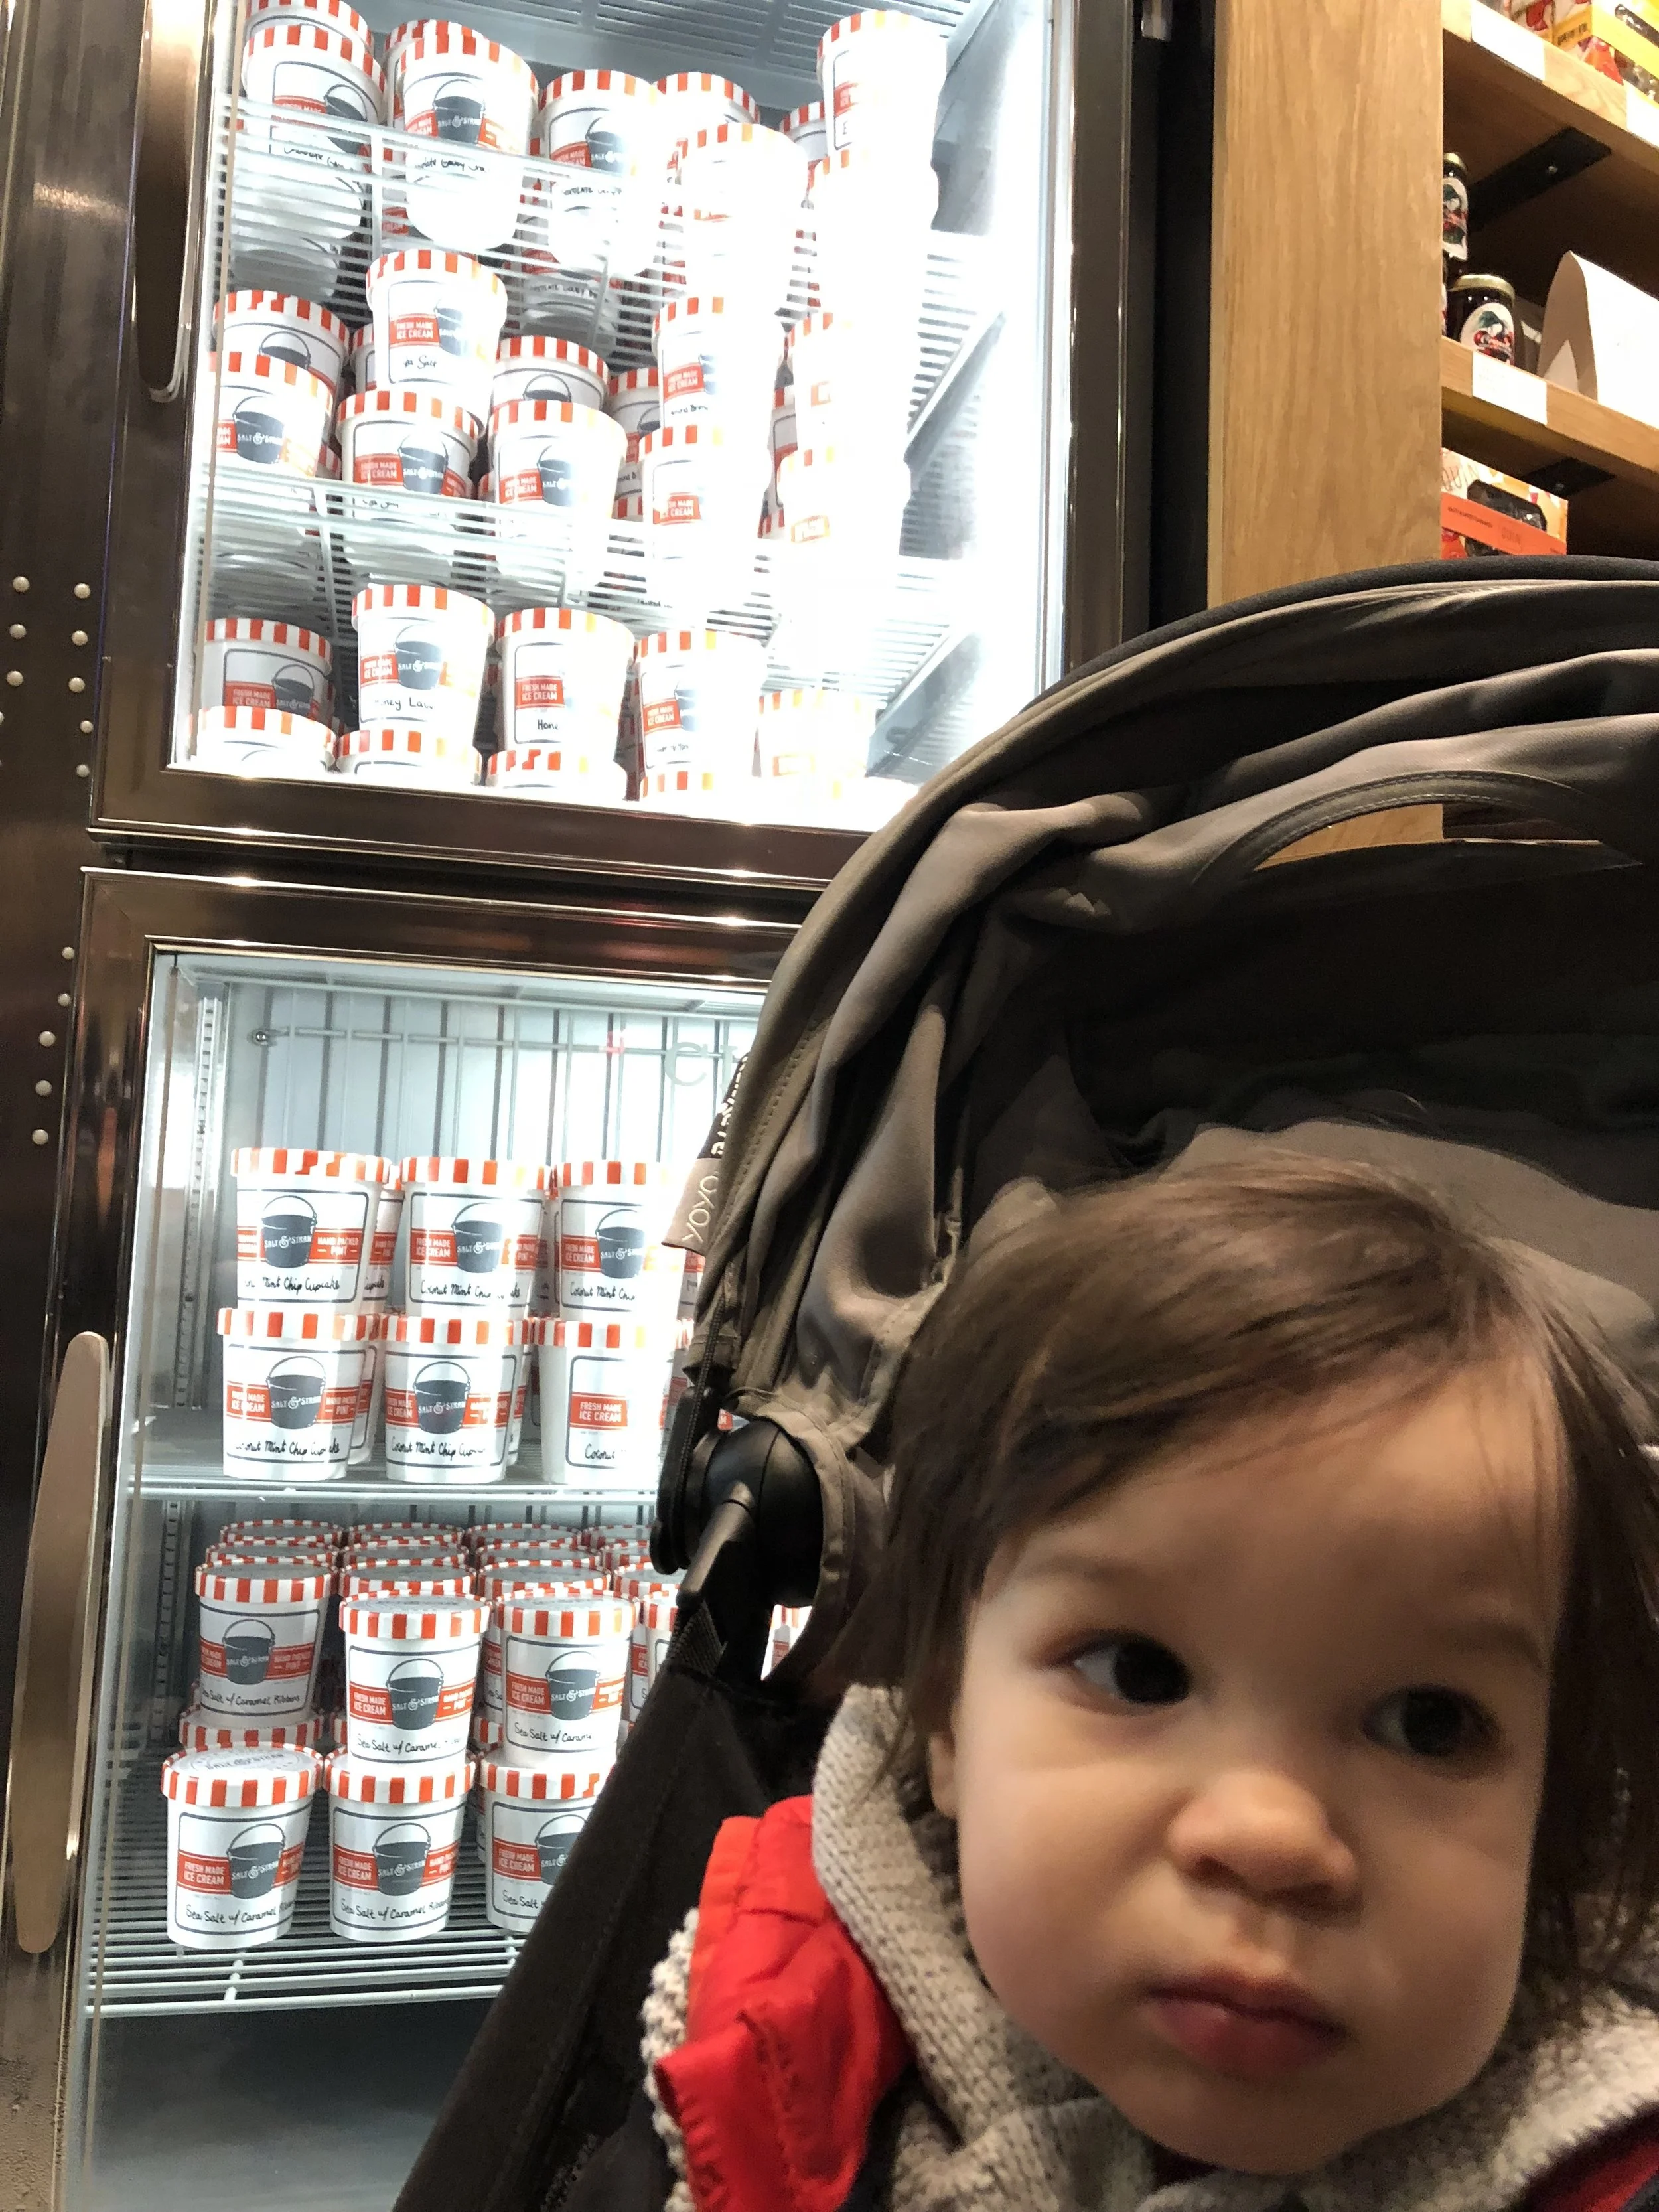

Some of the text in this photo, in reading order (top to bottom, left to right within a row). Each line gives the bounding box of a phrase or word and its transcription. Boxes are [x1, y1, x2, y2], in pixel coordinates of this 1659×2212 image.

[522, 691, 558, 701] ICE CREAM
[264, 1240, 279, 1248] SALT
[433, 1238, 451, 1248] MADE
[601, 1251, 614, 1260] SALT
[271, 1400, 287, 1408] SALT
[580, 1401, 602, 1410] FRESH
[579, 1410, 622, 1422] ICE CREAM
[369, 1696, 386, 1706] MADE
[521, 1692, 544, 1705] CREAM
[551, 1693, 566, 1702] SALT
[353, 1701, 386, 1716] ICE CREAM
[392, 1702, 407, 1711] SALT
[514, 1722, 528, 1737] Sea
[529, 1728, 548, 1742] Salt
[371, 1739, 392, 1753] Salt
[392, 1740, 404, 1755] w/
[184, 1860, 226, 1875] FRESH MADE
[509, 1860, 534, 1872] CREAM
[184, 1871, 224, 1885] ICE CREAM
[502, 1889, 539, 1909] Sea Salt
[186, 1904, 202, 1920] Sea
[203, 1911, 226, 1923] Salt
[228, 1909, 241, 1925] w/
[341, 1897, 354, 1914] Sea
[356, 1905, 376, 1919] Salt
[378, 1906, 389, 1921] w/
